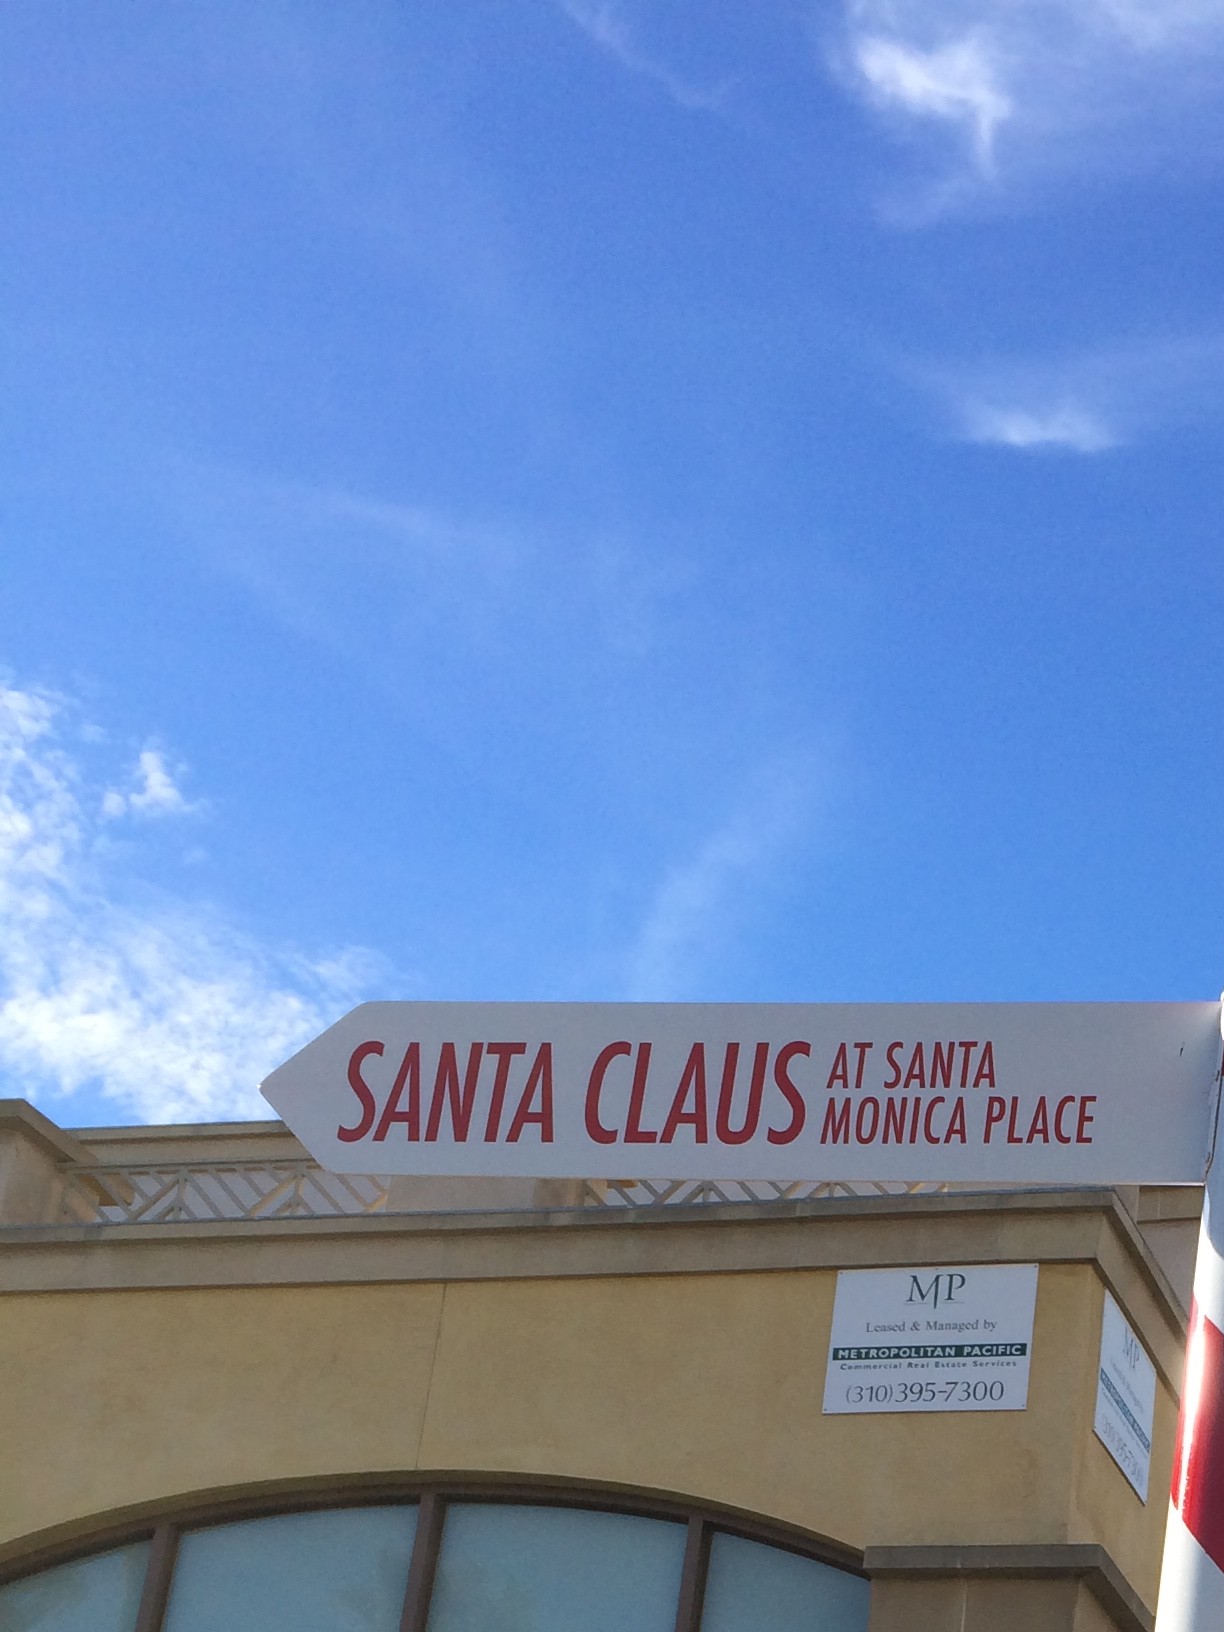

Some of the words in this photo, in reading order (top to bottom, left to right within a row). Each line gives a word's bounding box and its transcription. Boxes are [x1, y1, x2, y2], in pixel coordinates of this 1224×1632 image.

[826, 1042, 873, 1089] AT
[884, 1041, 997, 1090] SANTA
[337, 1040, 554, 1143] SANTA
[585, 1041, 812, 1146] CLAUS
[820, 1096, 968, 1145] MONICA
[983, 1095, 1097, 1145] PLACE
[906, 1273, 966, 1309] MP
[866, 1321, 906, 1333] Leased
[910, 1320, 921, 1331] &
[925, 1319, 979, 1333] Managed
[983, 1319, 998, 1332] by
[838, 1346, 956, 1359] METROPOLITAN
[963, 1344, 1022, 1356] PACIFIC
[840, 1361, 902, 1371] Commercial
[907, 1361, 930, 1369] Real
[935, 1360, 967, 1369] Estate
[972, 1359, 1017, 1368] Services
